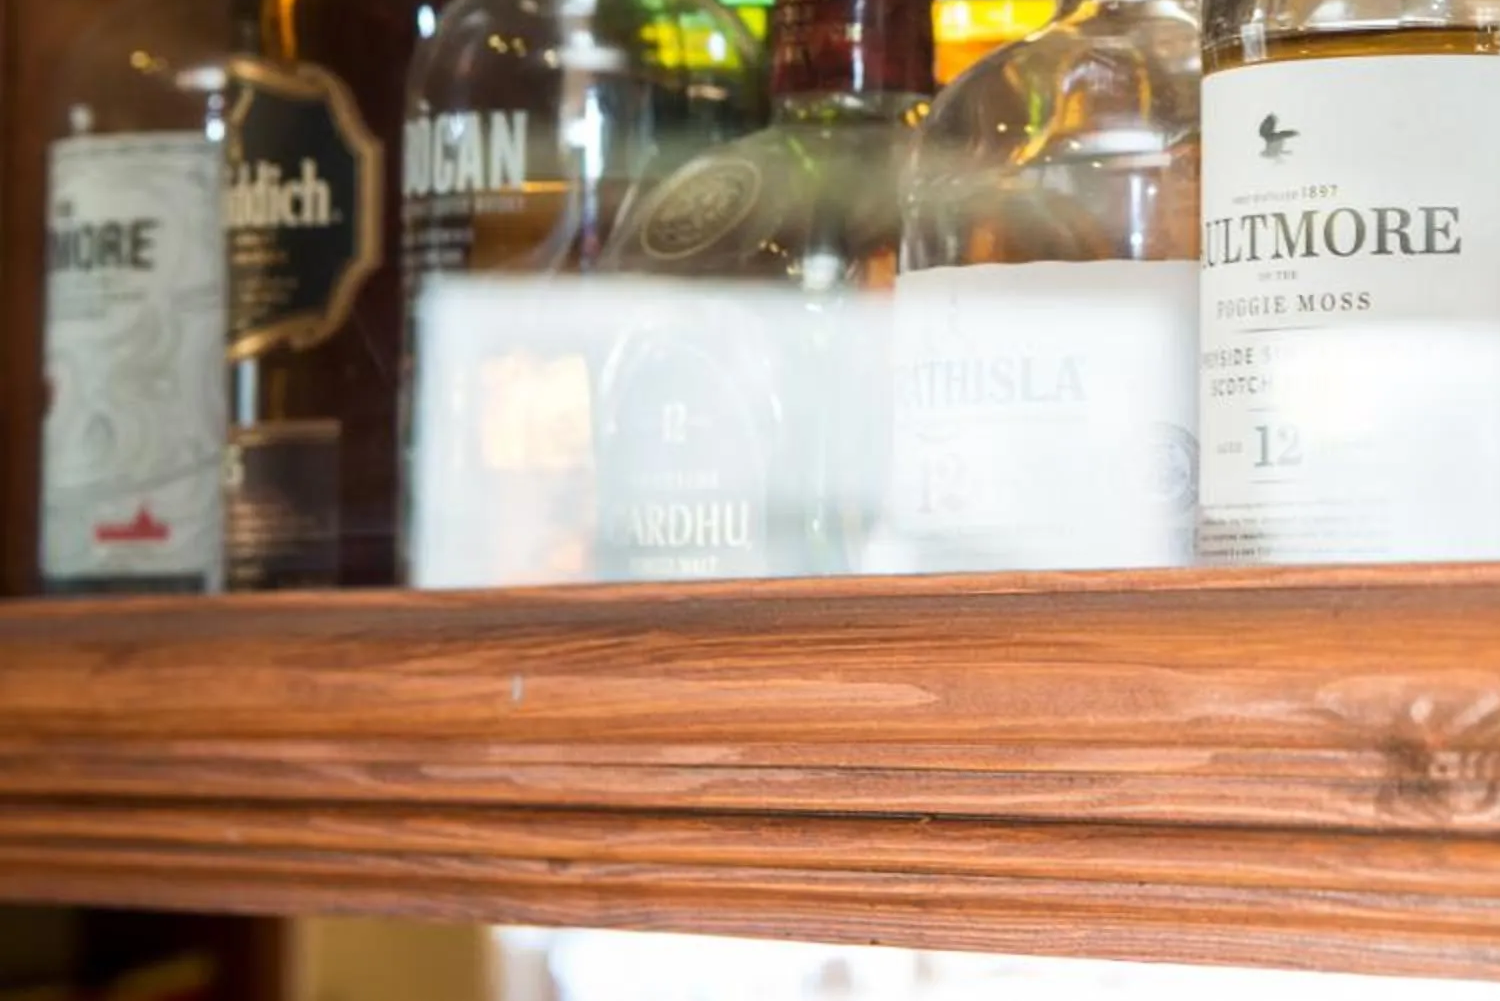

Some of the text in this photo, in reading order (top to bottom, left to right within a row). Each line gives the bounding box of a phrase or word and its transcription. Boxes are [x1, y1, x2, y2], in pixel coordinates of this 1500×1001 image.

[1201, 206, 1461, 270] ULTMORE
[1298, 292, 1371, 312] MOSS
[1253, 423, 1302, 468] 12
